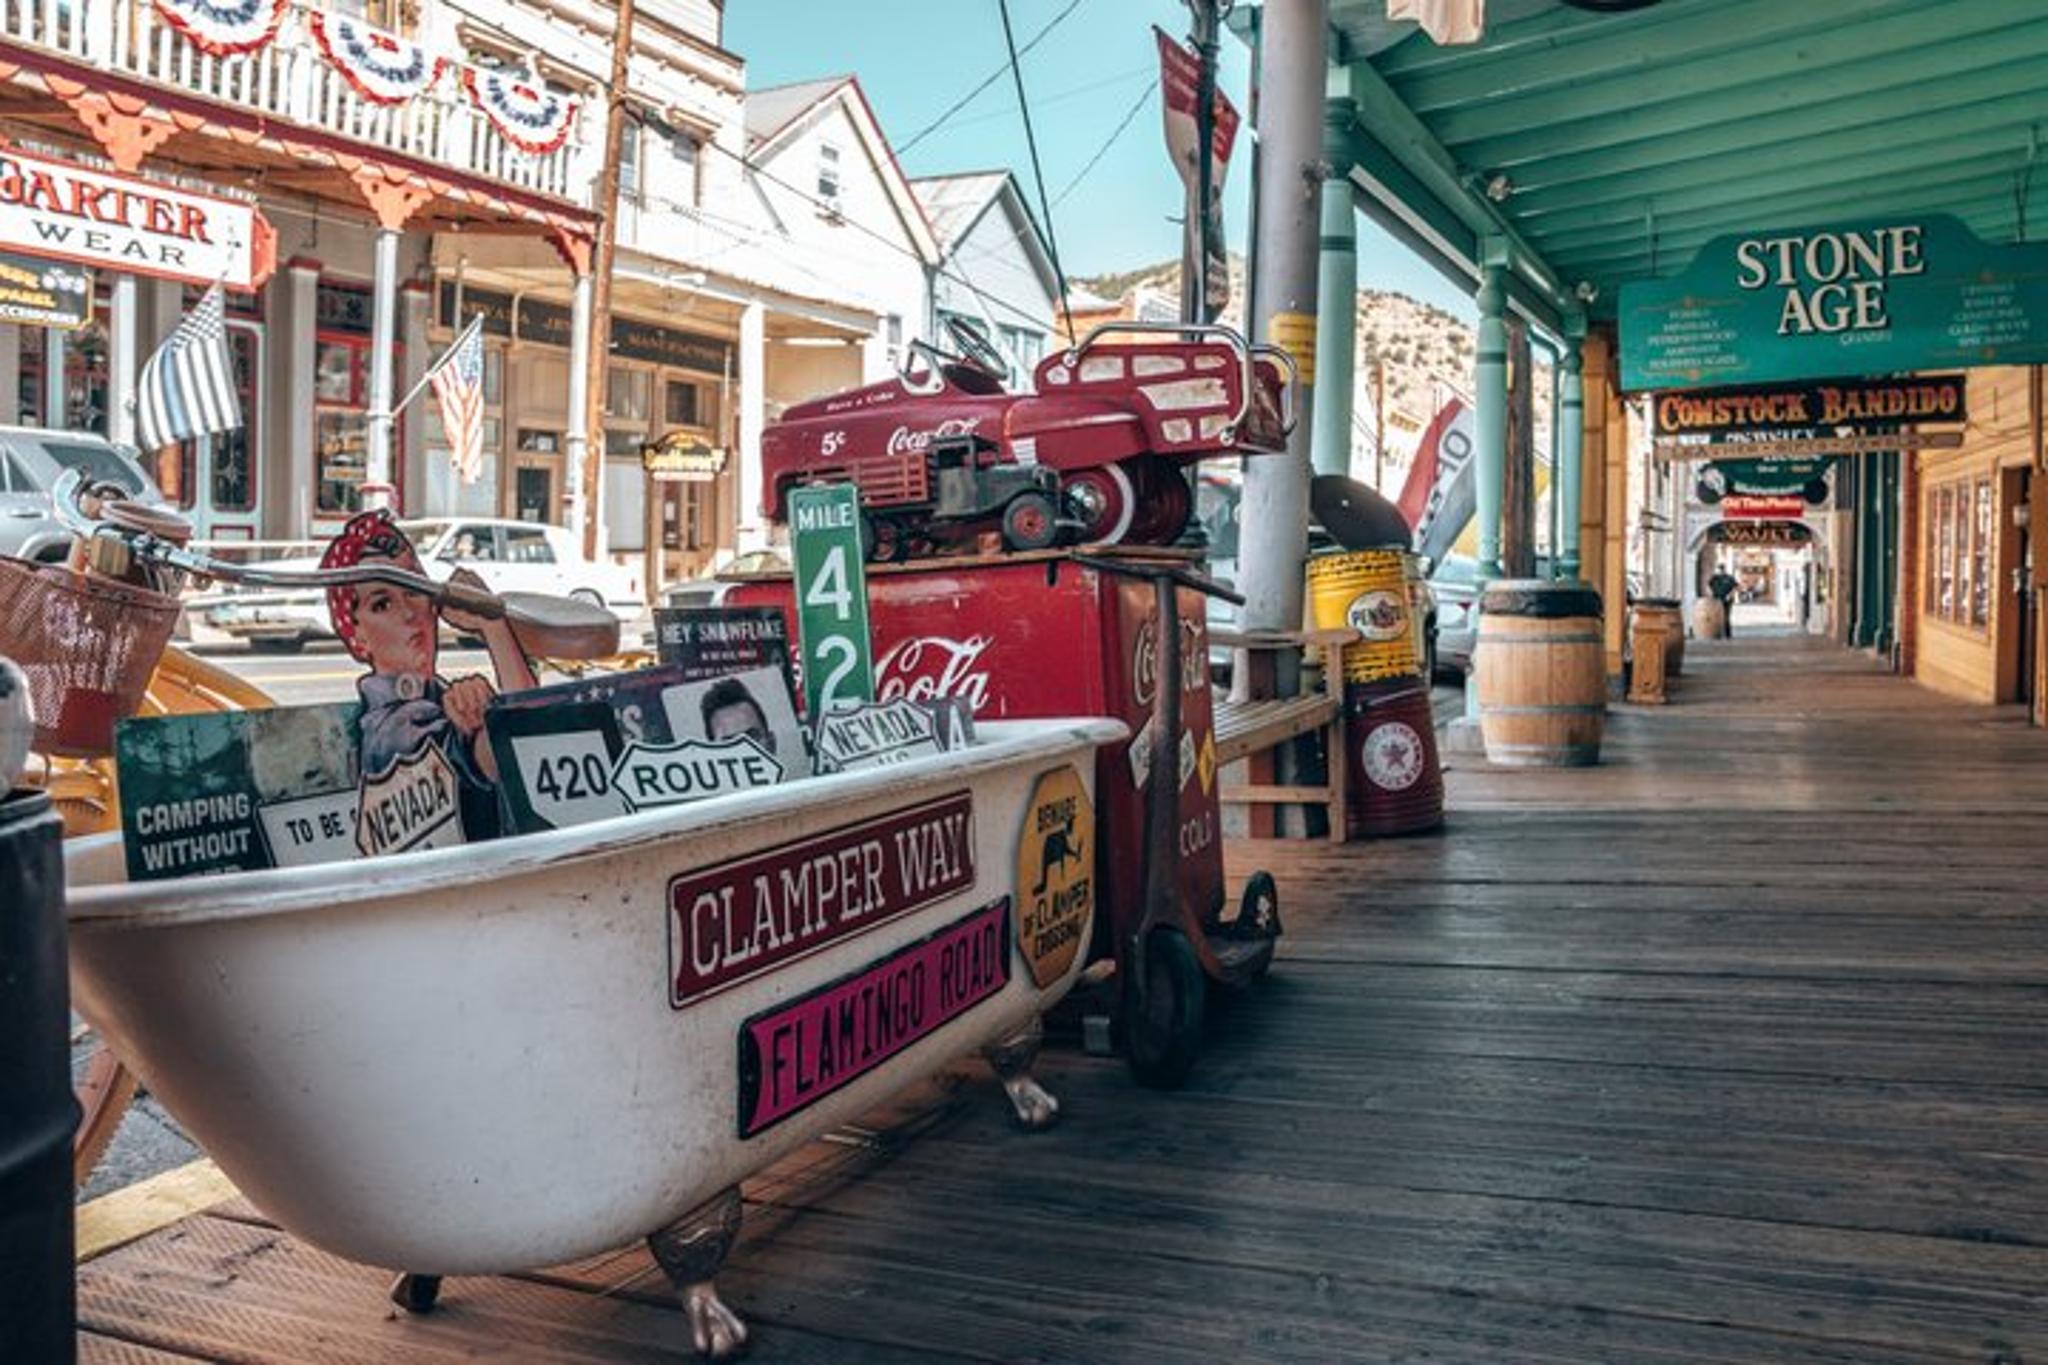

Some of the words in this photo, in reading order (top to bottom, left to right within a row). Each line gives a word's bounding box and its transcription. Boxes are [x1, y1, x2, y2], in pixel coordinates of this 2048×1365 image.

[32, 218, 188, 268] WEAR
[1737, 225, 1925, 289] STONE
[1777, 280, 1888, 335] AGE
[1658, 393, 1808, 432] COMSTOCK
[1818, 384, 1958, 424] BANDIDO
[798, 503, 852, 530] MILE
[806, 546, 852, 621] 4
[662, 623, 692, 644] HEY
[815, 634, 862, 714] 2
[827, 705, 917, 758] NEVADA
[536, 753, 609, 801] 420
[632, 756, 770, 798] ROUTE
[135, 793, 250, 835] CAMPING
[286, 819, 314, 846] TO
[323, 810, 346, 838] BE
[365, 770, 452, 852] NEVADA
[1037, 795, 1077, 833] BEWARE
[141, 828, 251, 872] WITHOUT
[690, 841, 886, 977] CLAMPER
[895, 811, 964, 897] WAY
[772, 959, 926, 1108] FLAMINGO
[940, 921, 997, 1011] ROAD
